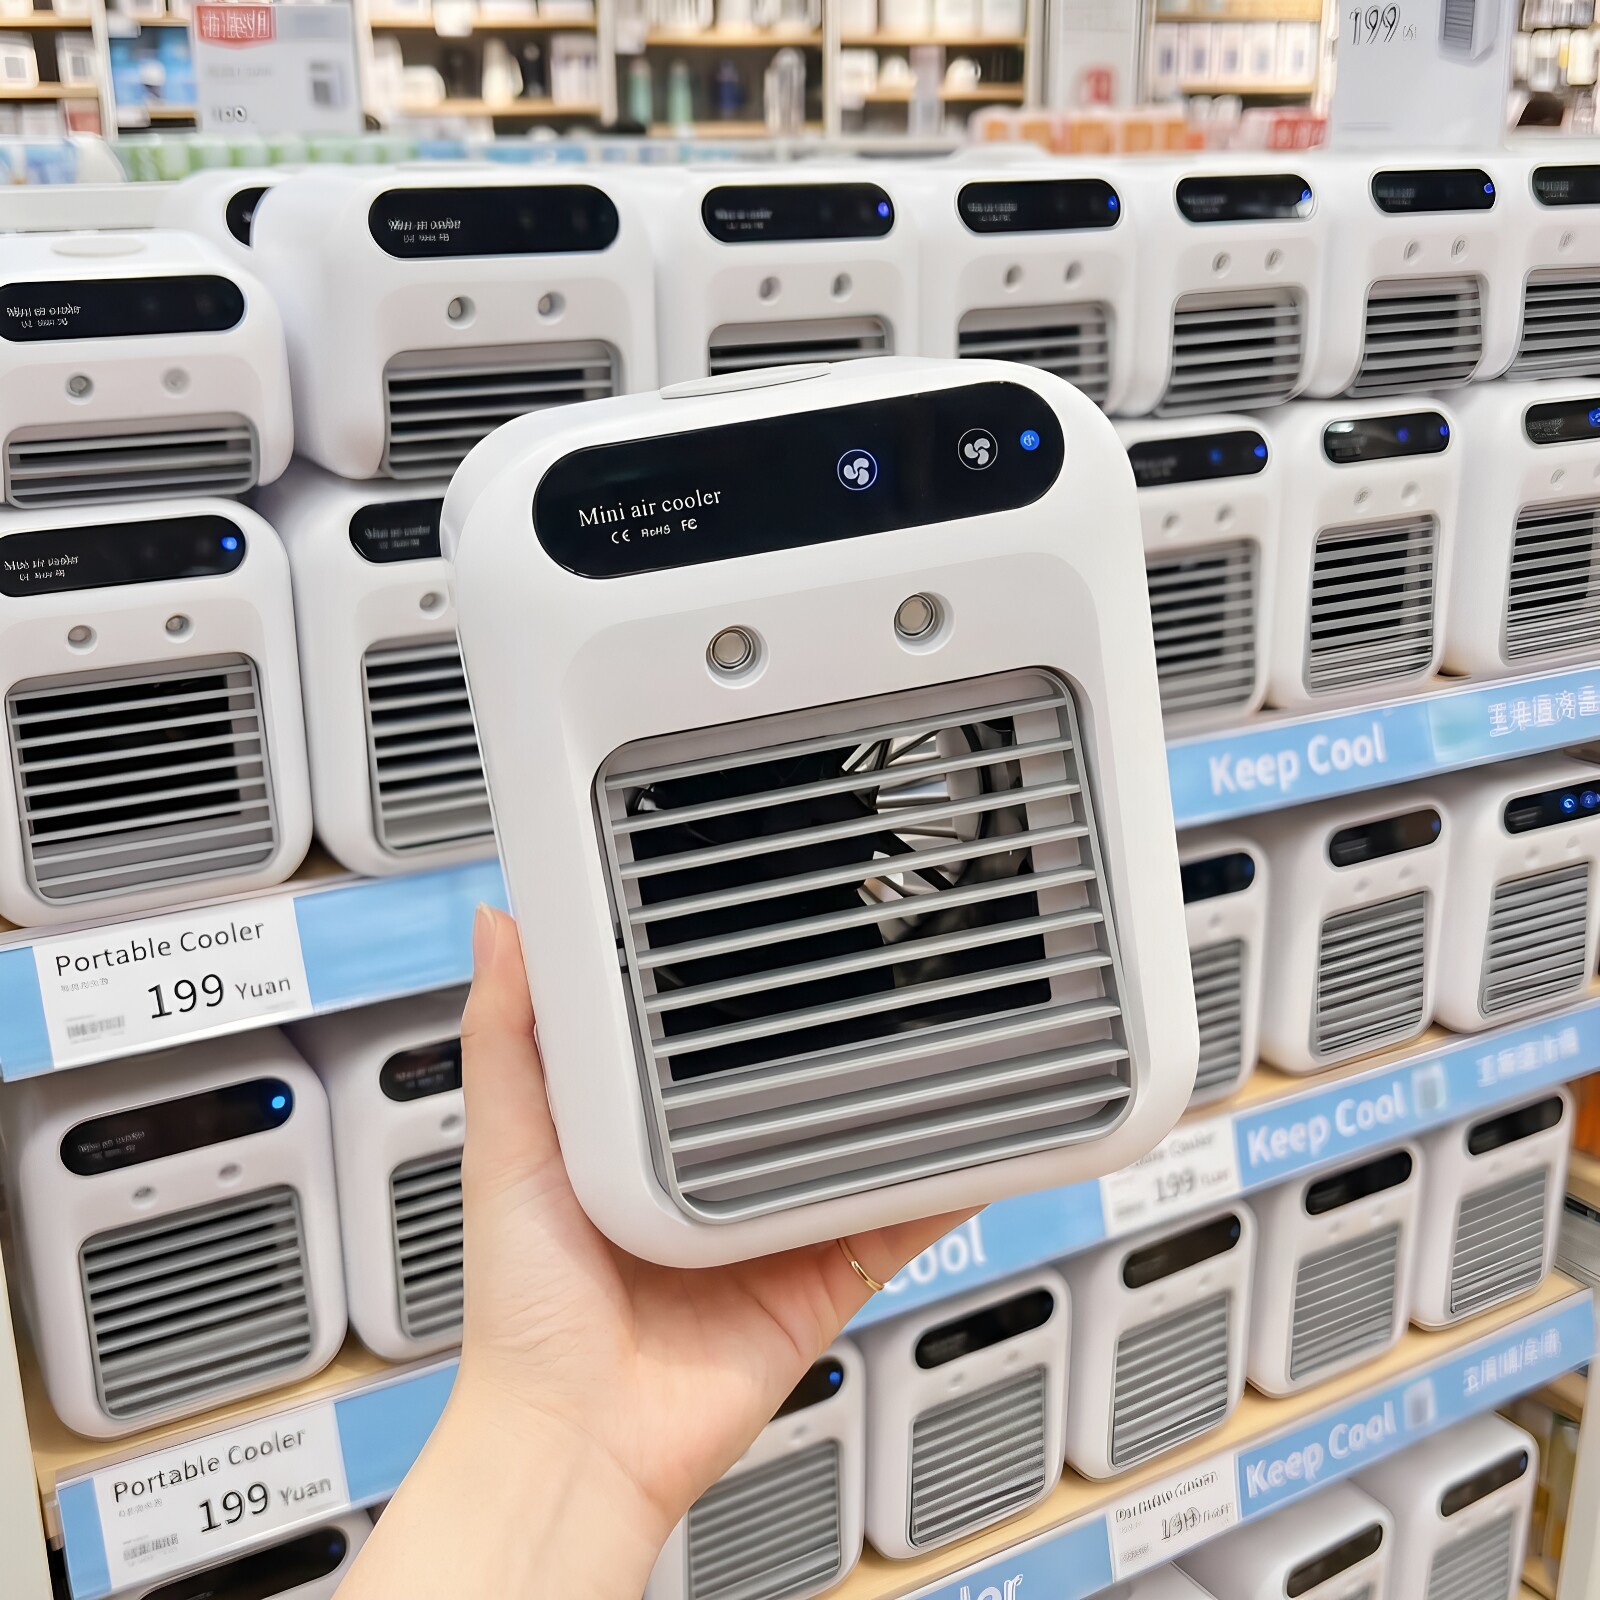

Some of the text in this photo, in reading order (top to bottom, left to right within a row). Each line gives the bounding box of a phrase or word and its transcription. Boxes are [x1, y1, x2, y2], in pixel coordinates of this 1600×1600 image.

[578, 488, 721, 527] Mini air cooler
[611, 529, 631, 544] CE
[1208, 721, 1387, 795] Keep Cool
[55, 922, 264, 976] Portable Cooler
[148, 973, 225, 1019] 199
[234, 977, 292, 1000] Yuan
[1247, 1081, 1405, 1167] Keep Cool
[883, 1214, 988, 1294] ool
[113, 1430, 306, 1503] Portable Cooler
[1246, 1442, 1325, 1498] Keep
[1328, 1399, 1398, 1460] Cool
[198, 1481, 270, 1533] 199
[279, 1476, 332, 1506] Yuan
